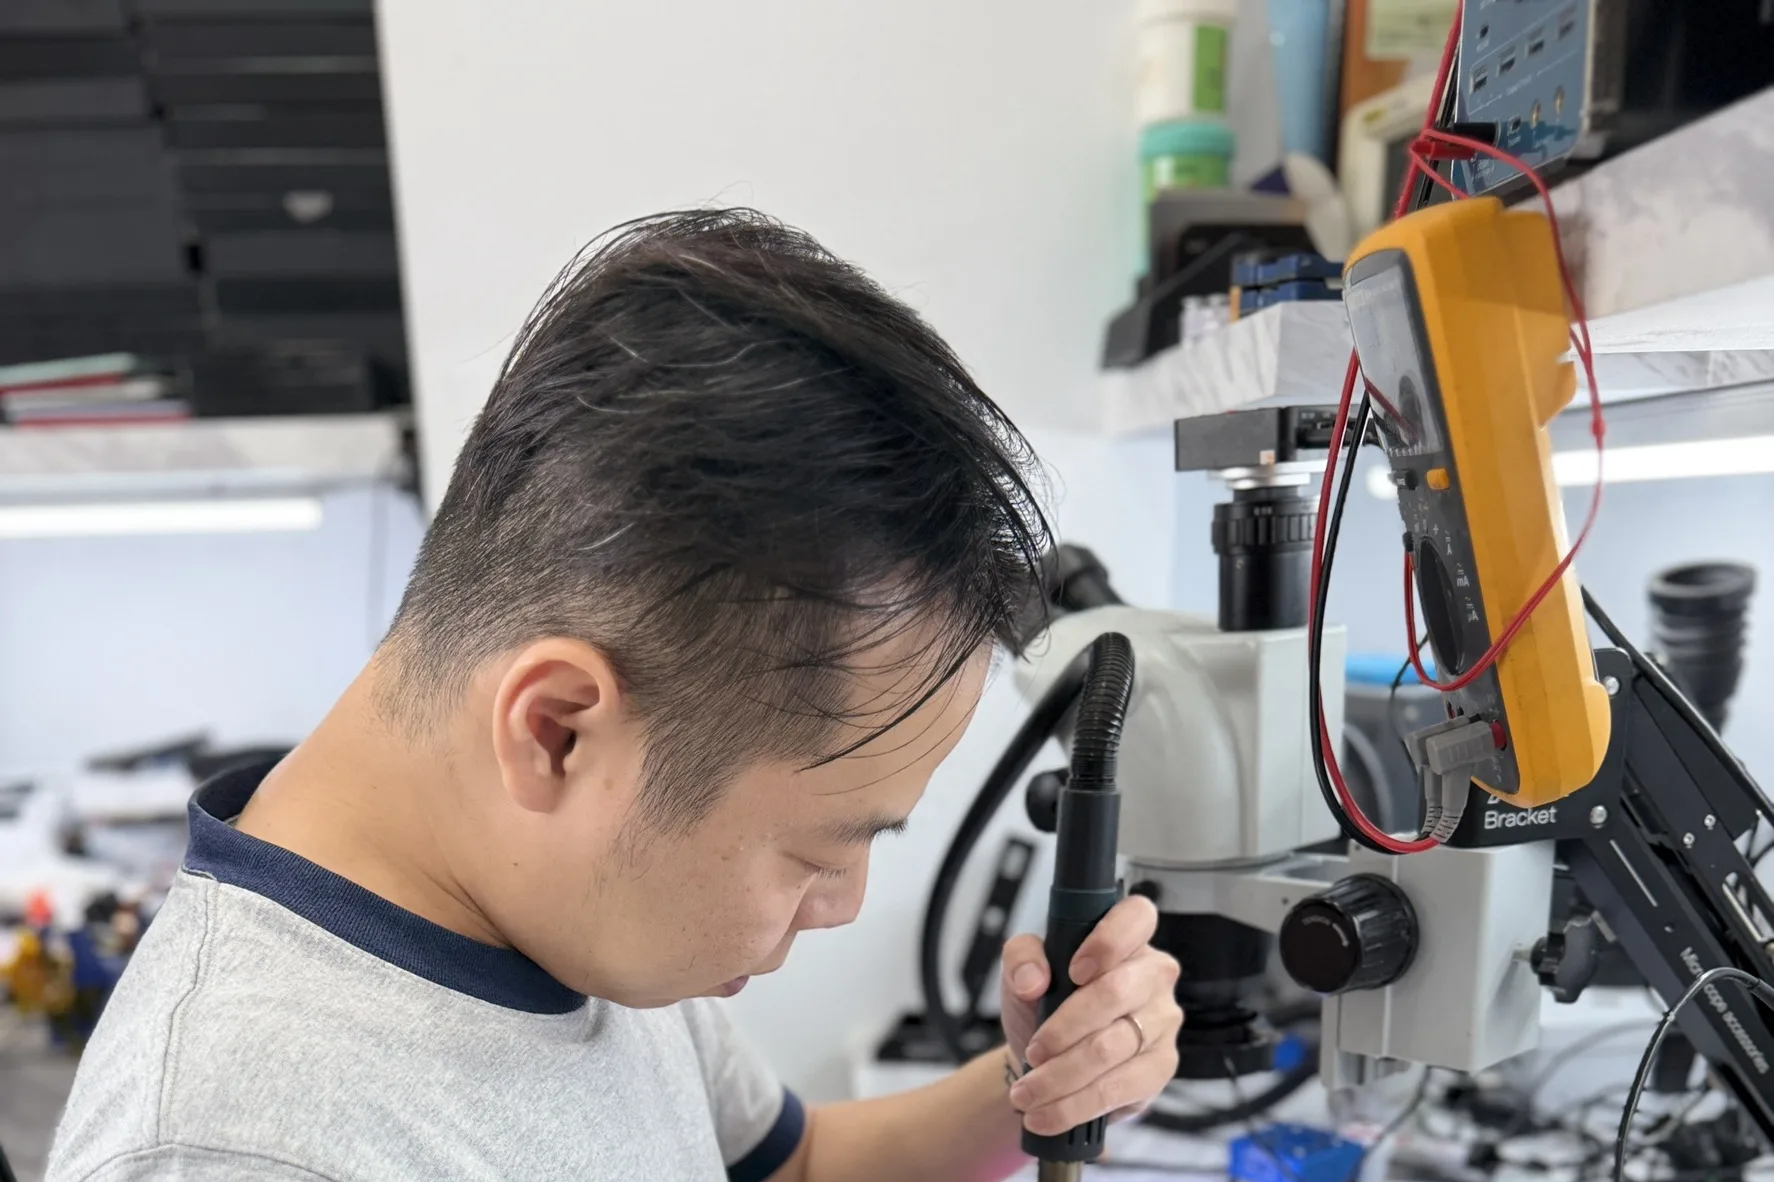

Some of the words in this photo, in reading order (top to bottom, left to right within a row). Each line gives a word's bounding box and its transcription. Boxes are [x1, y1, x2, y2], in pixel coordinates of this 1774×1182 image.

[1456, 575, 1470, 587] mA
[1484, 806, 1557, 829] Bracket
[1680, 946, 1728, 1013] Micrcope
[1722, 1011, 1769, 1074] accessories
